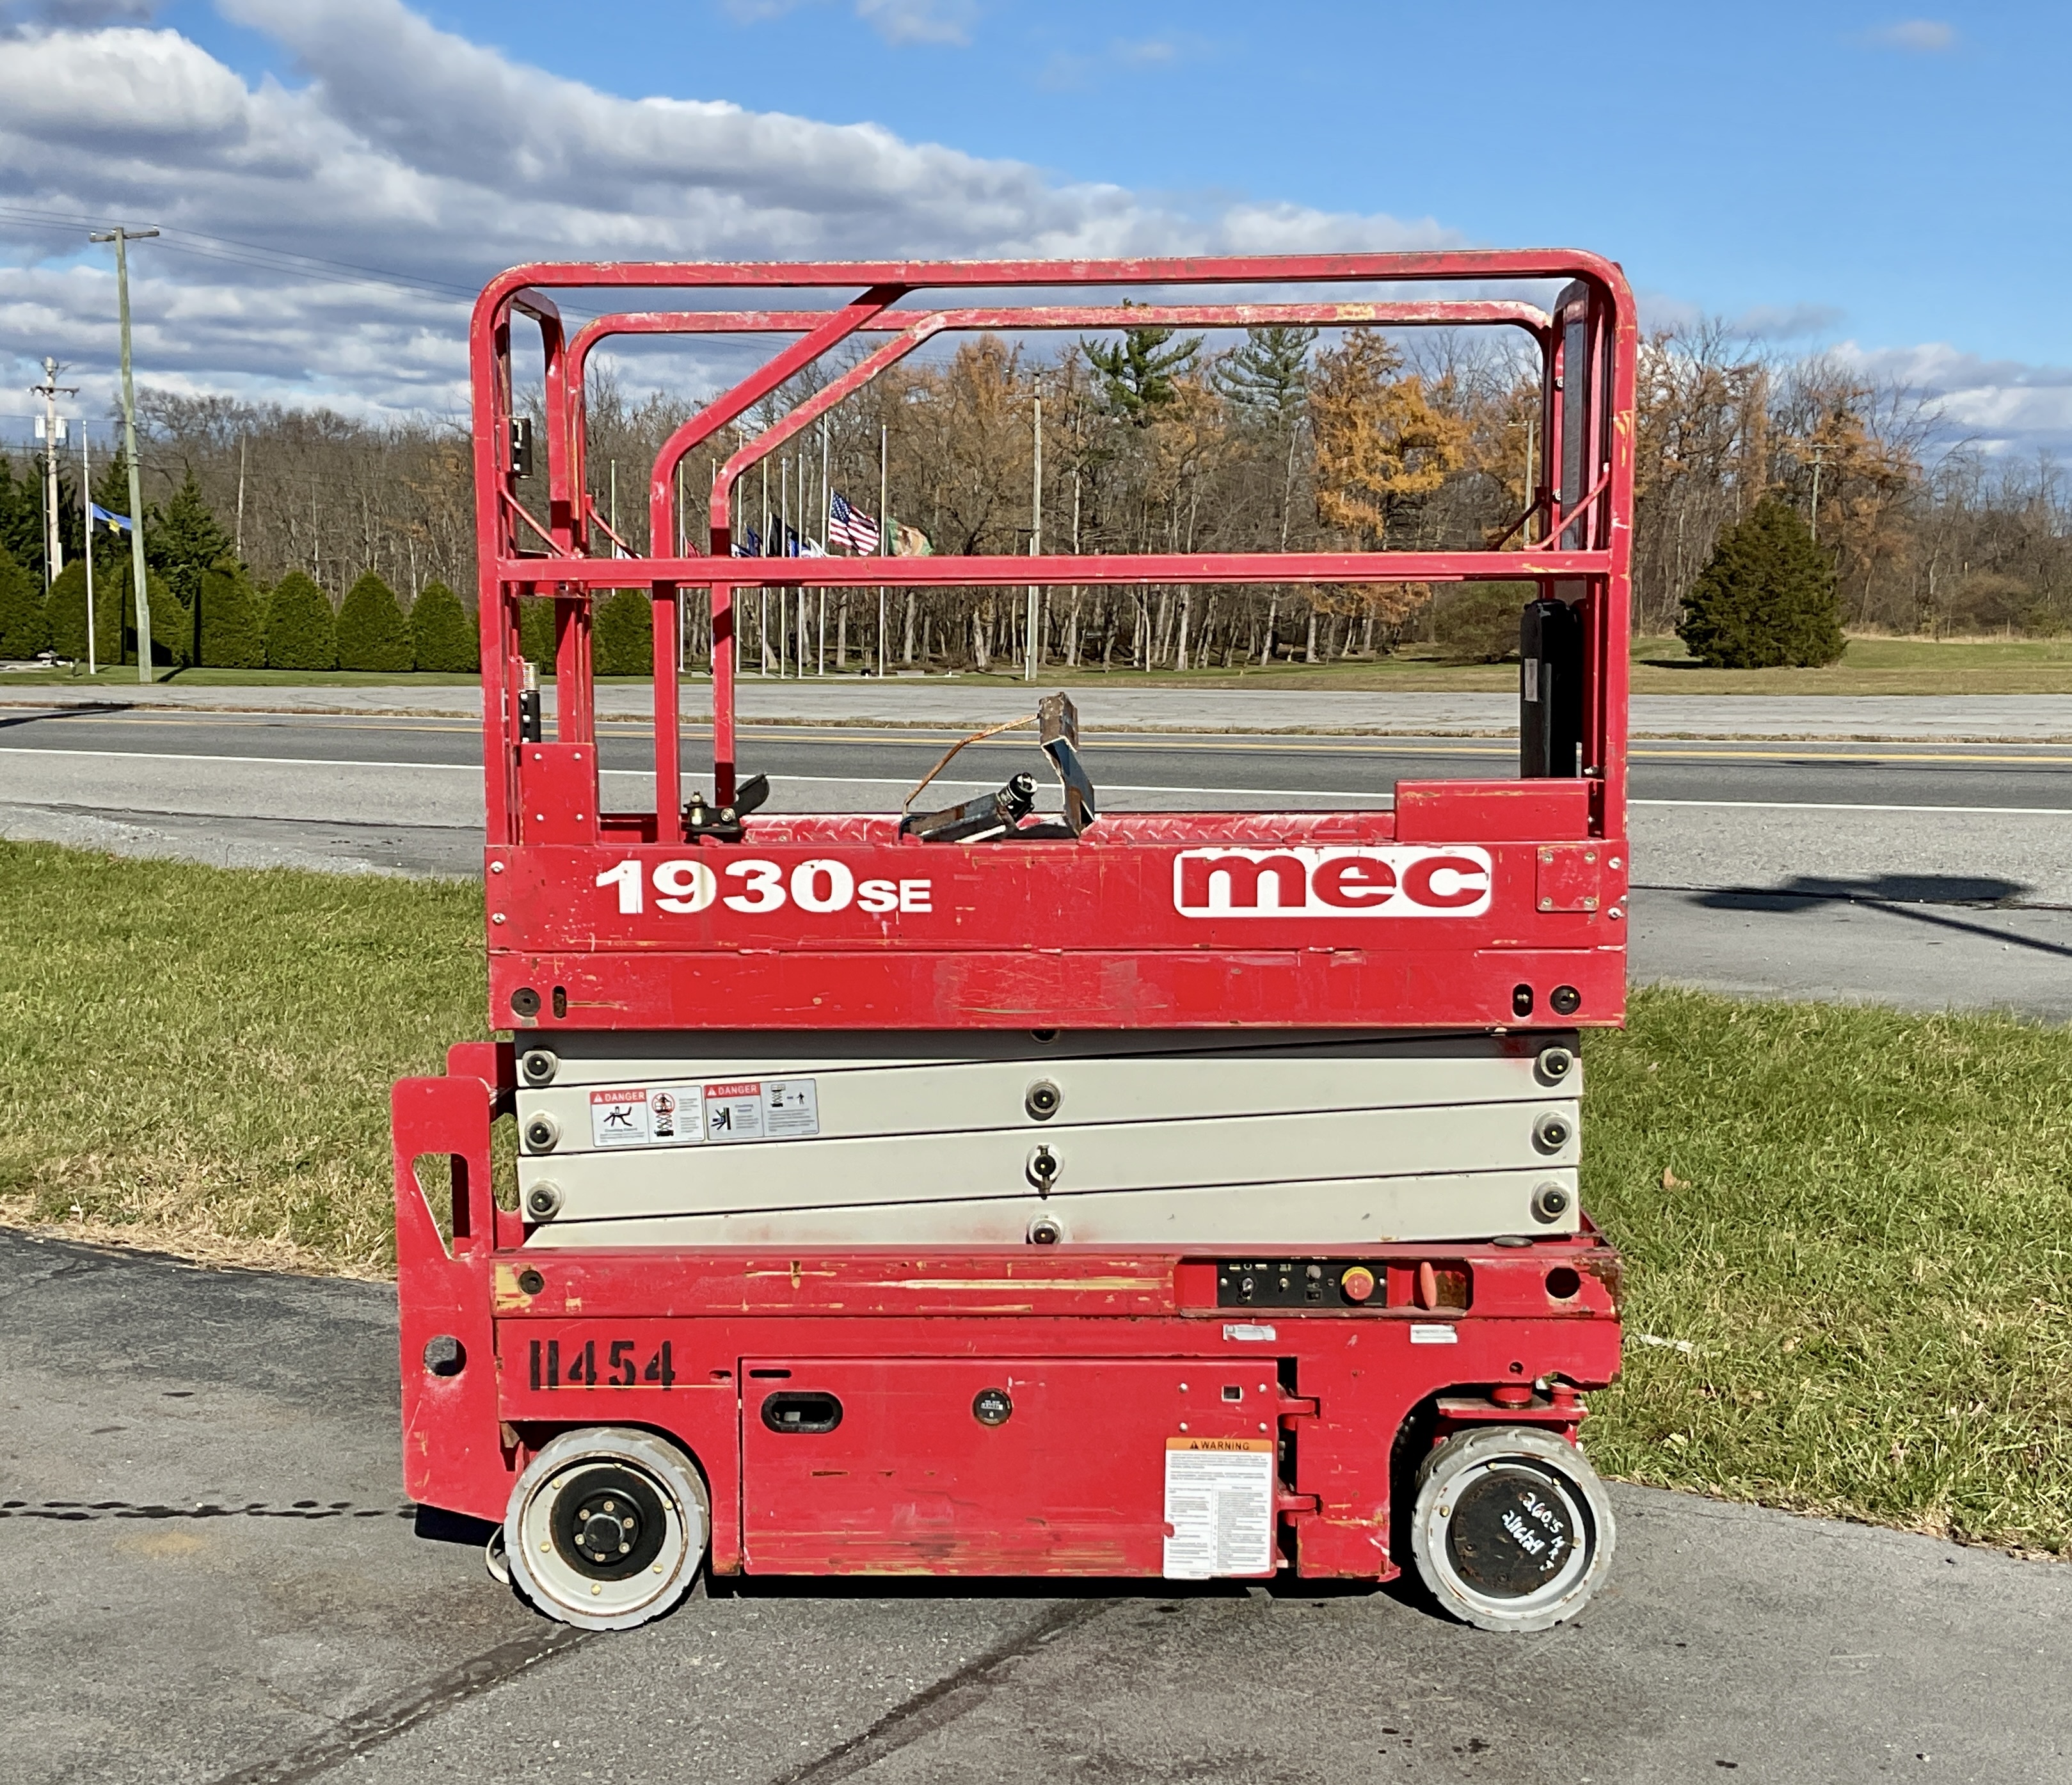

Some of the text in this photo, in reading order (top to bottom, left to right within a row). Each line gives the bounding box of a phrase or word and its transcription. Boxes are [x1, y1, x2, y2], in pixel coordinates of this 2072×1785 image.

[1181, 855, 1487, 908] mec
[718, 1085, 758, 1095] DANGER
[604, 1091, 646, 1102] DANGER
[530, 1340, 676, 1391] 11454
[1200, 1440, 1250, 1450] WARNING
